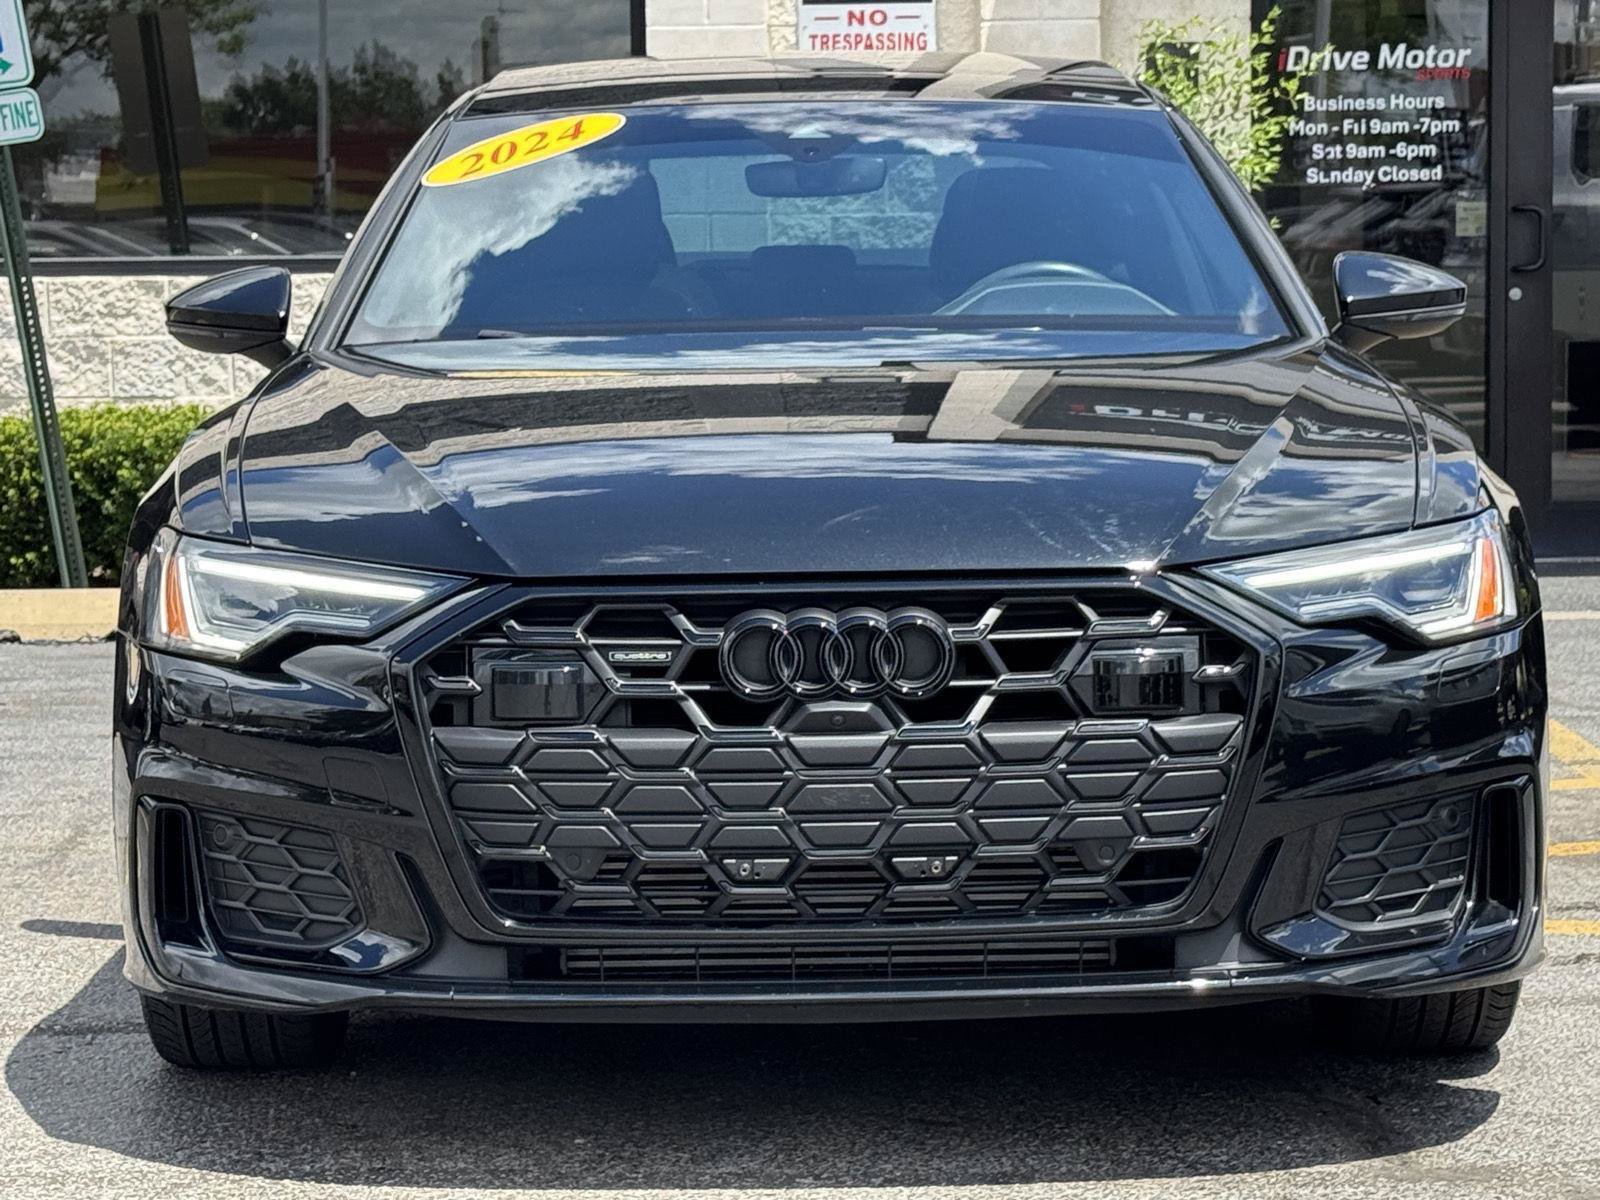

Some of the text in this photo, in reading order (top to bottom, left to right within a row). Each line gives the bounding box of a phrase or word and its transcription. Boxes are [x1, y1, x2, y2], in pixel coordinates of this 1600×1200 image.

[847, 10, 888, 26] NO
[808, 32, 927, 50] TRESPASSING
[1277, 42, 1471, 72] iDrive Motor
[1303, 94, 1445, 112] Business Hours
[0, 101, 38, 131] FINE
[1288, 120, 1328, 136] Mon
[1369, 118, 1410, 135] 9am
[459, 119, 586, 179] 2024
[1312, 143, 1343, 160] Sat
[1346, 142, 1385, 159] 9am
[1306, 164, 1443, 187] Sunday Closed
